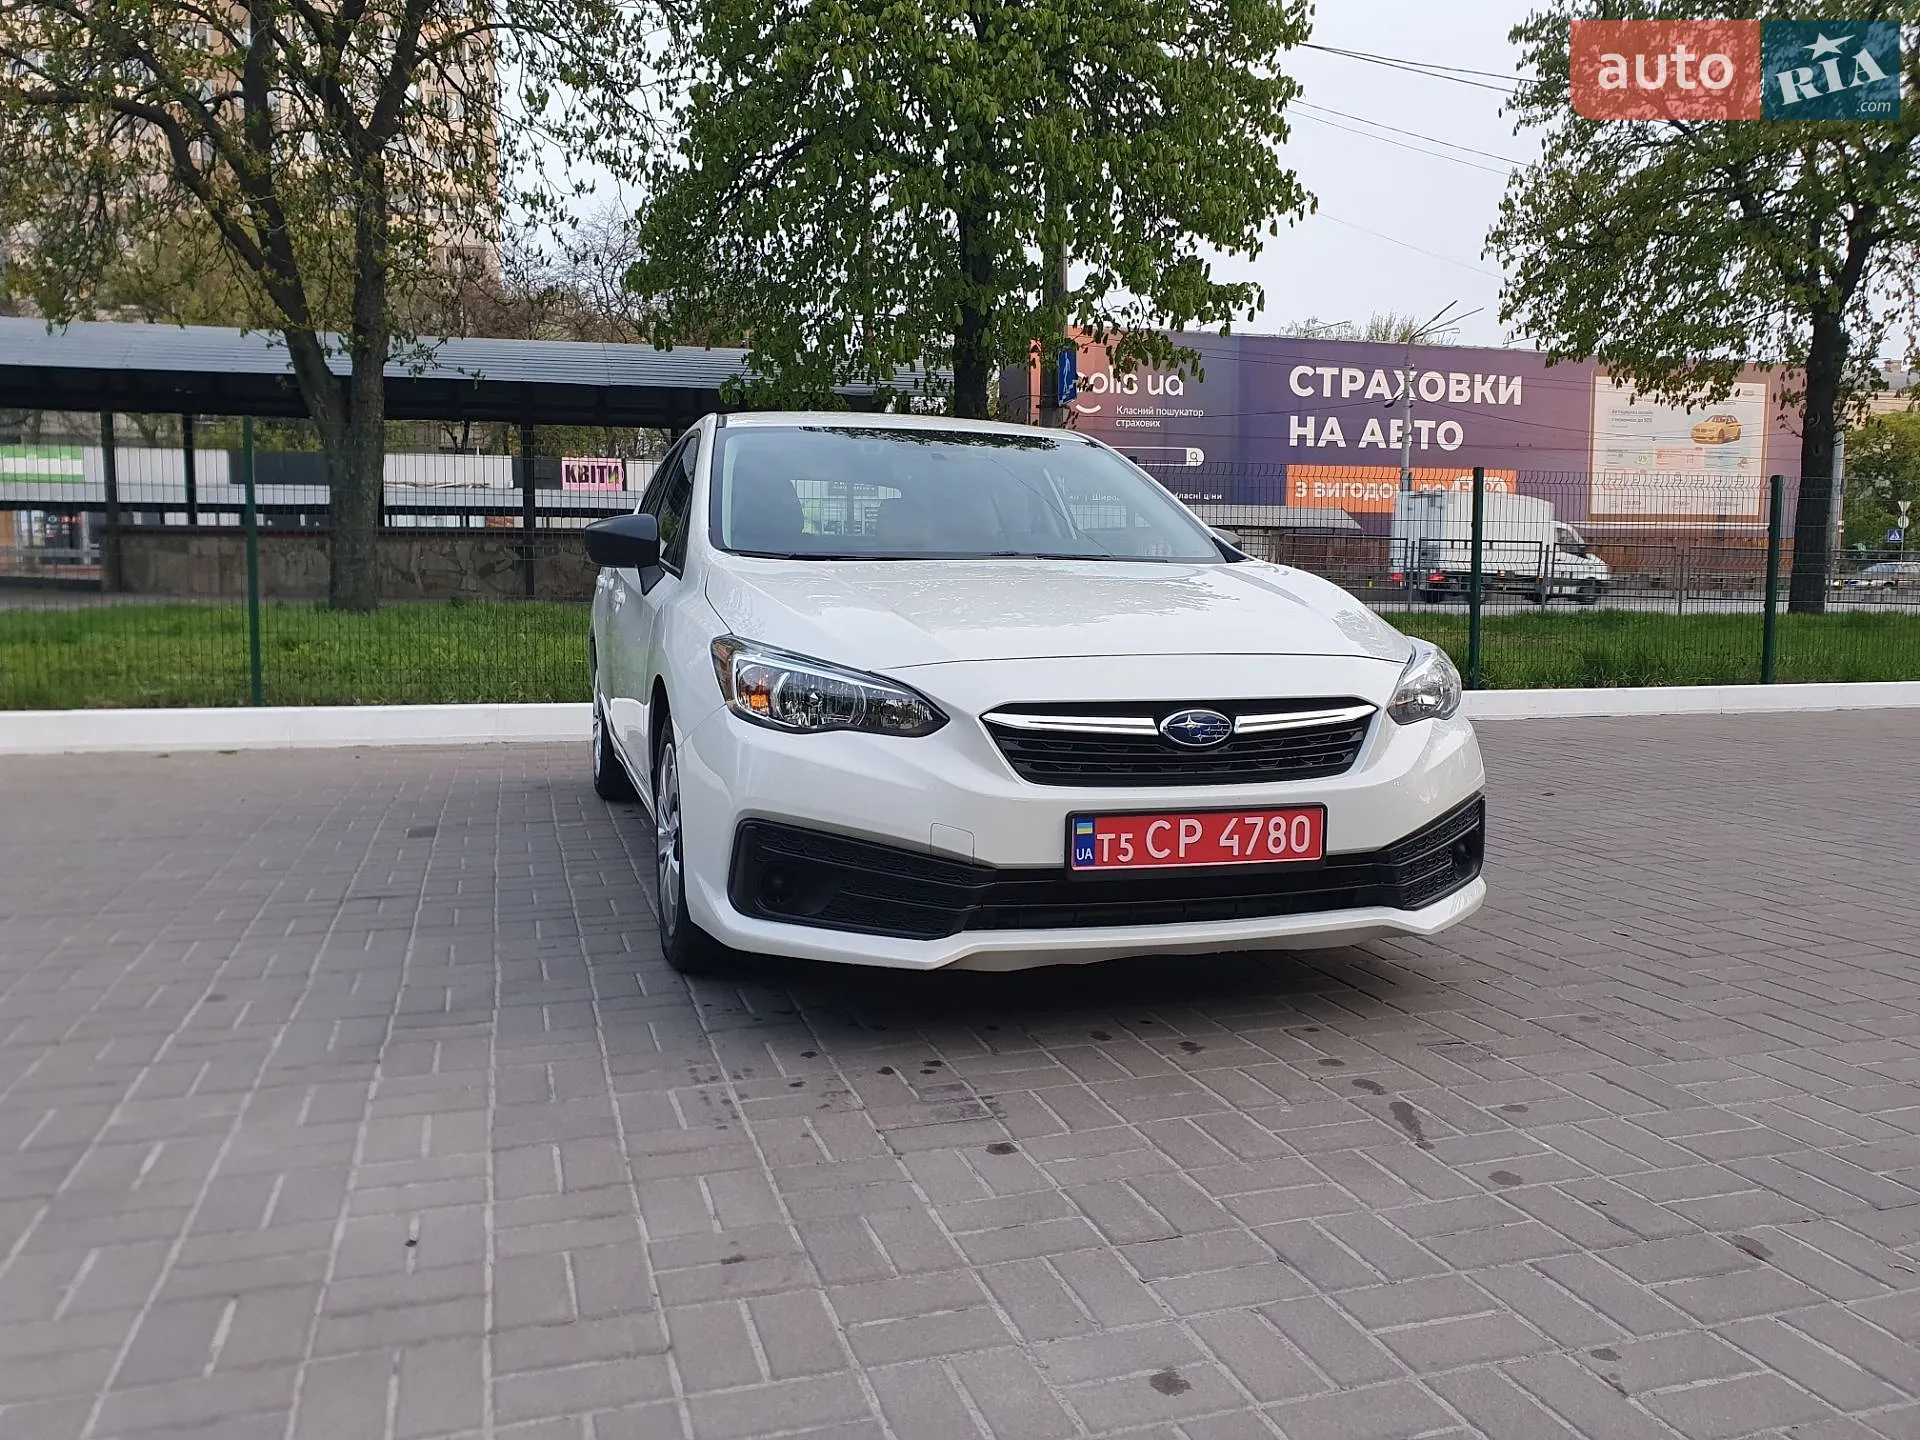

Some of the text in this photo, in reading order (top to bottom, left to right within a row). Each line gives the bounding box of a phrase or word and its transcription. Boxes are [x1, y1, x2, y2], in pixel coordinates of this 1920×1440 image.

[1289, 365, 1522, 406] СТРАХОВКИ
[1116, 405, 1154, 416] Класний
[1155, 408, 1204, 418] пошукатор
[1116, 419, 1161, 428] страхових
[1289, 415, 1464, 451] НА АВТО
[565, 465, 619, 484] КВІТИ
[1313, 482, 1401, 502] ВИГОДО
[1097, 815, 1311, 862] T5 CP 4780
[1076, 848, 1093, 861] UA
